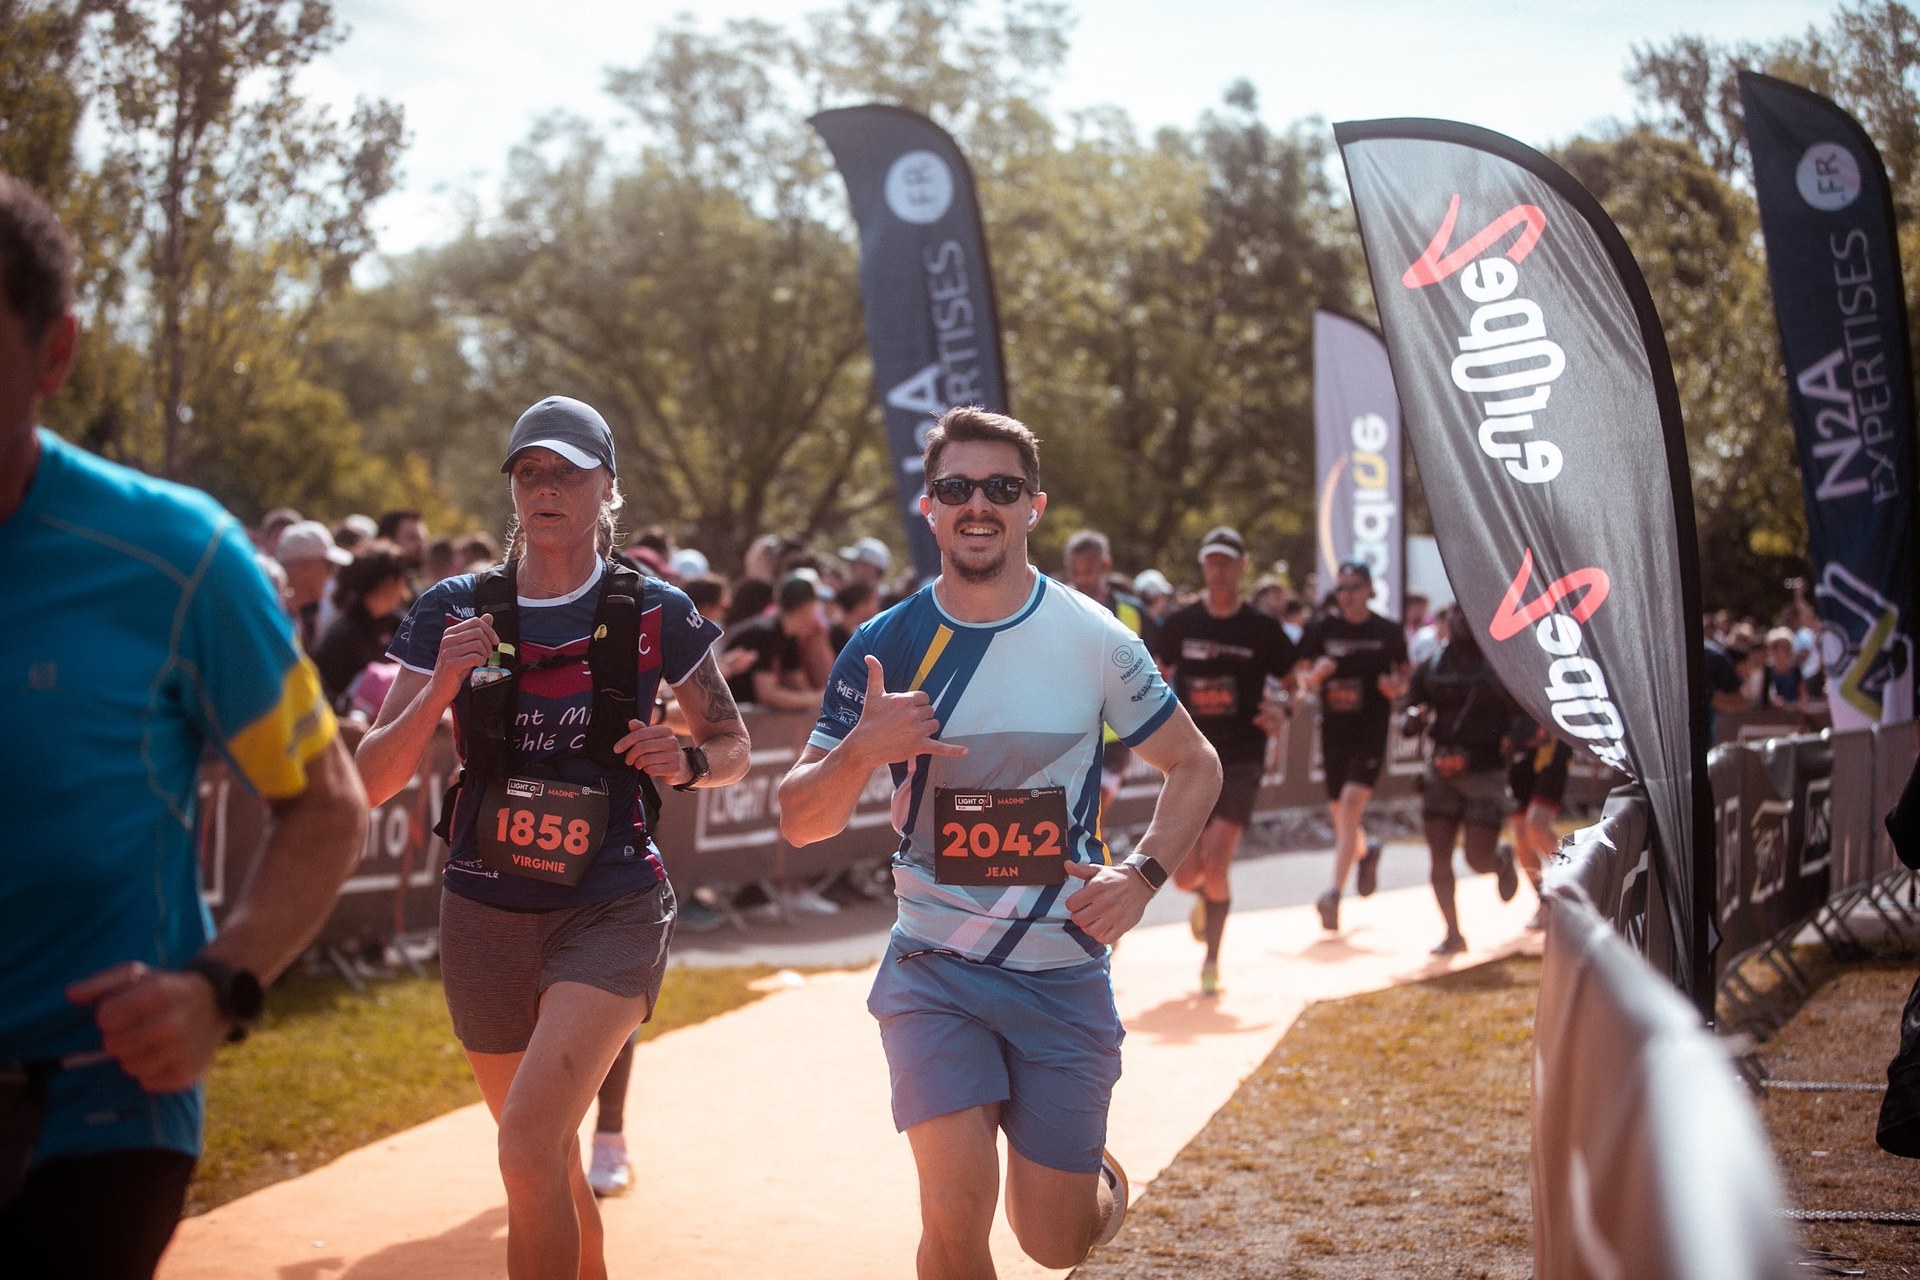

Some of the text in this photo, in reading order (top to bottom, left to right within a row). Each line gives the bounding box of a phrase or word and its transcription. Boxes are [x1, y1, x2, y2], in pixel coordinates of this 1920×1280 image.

[928, 240, 982, 404] RTISES
[1830, 228, 1898, 502] EXPERTISES
[1797, 348, 1873, 500] N2A
[515, 706, 593, 726] nt Mi
[569, 734, 586, 749] C
[510, 781, 529, 791] LIGHT
[496, 807, 591, 856] 1858
[941, 820, 1062, 858] 2042
[511, 853, 566, 874] VIRGINIE
[985, 866, 1019, 878] JEAN
